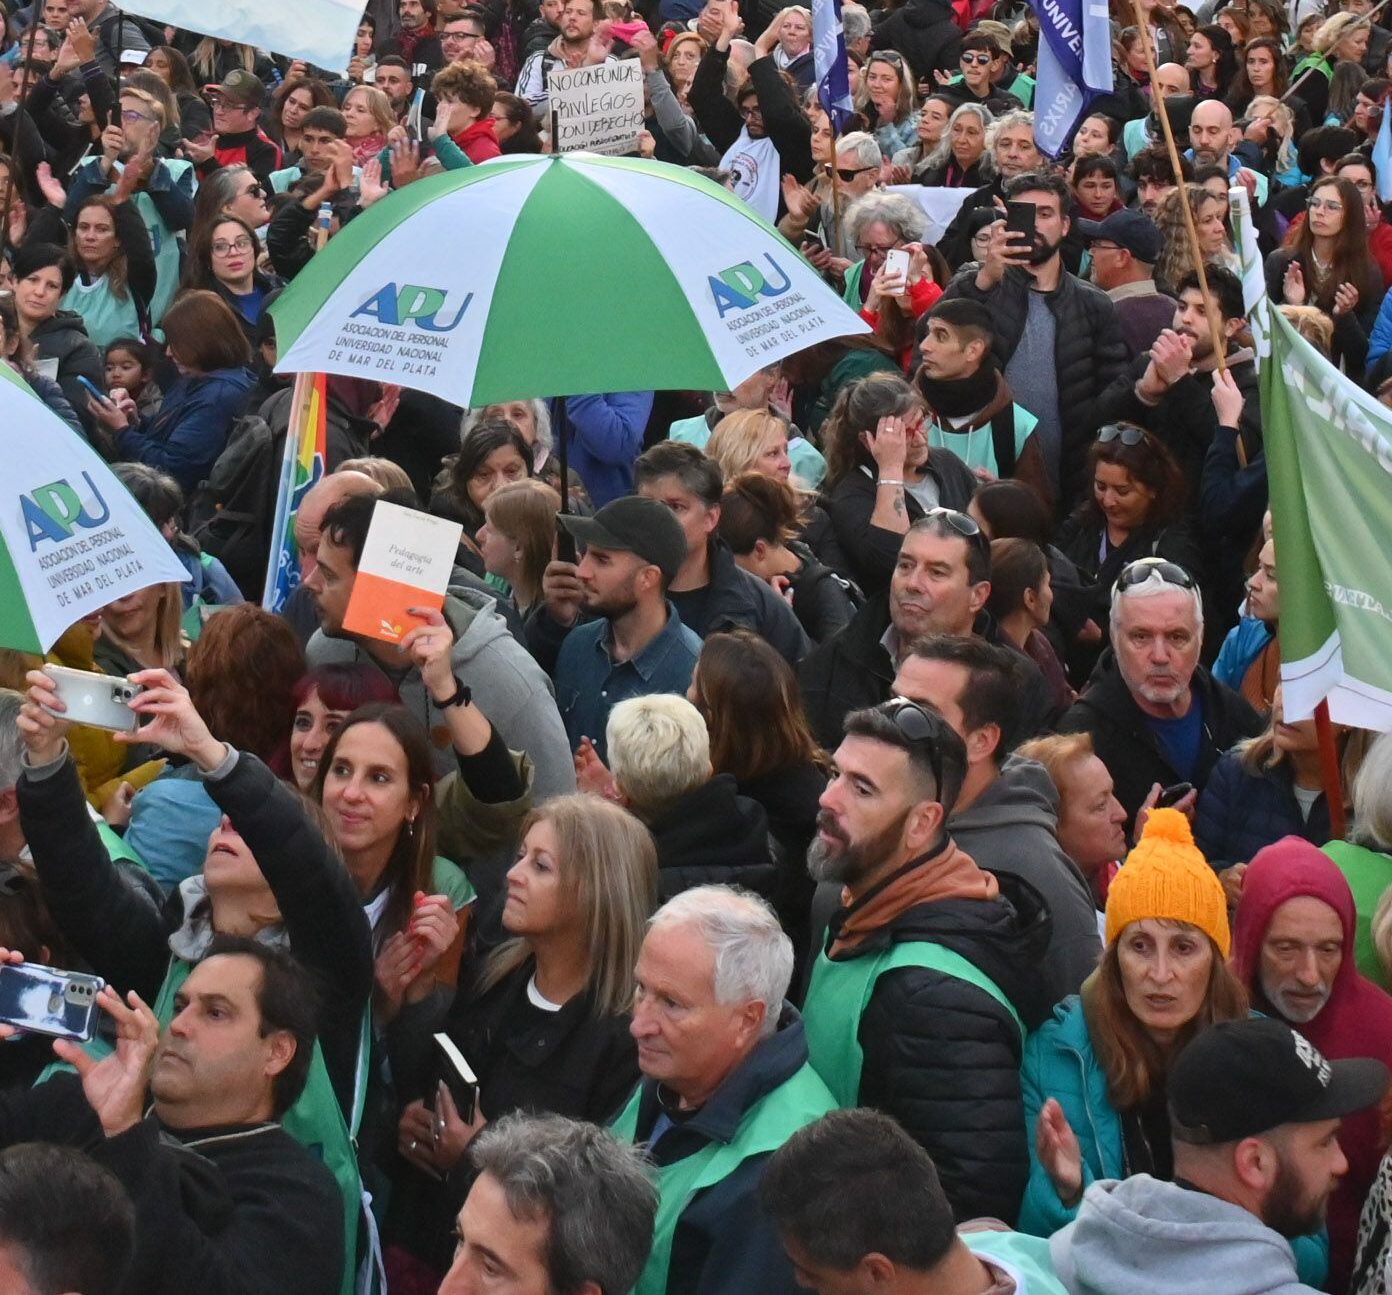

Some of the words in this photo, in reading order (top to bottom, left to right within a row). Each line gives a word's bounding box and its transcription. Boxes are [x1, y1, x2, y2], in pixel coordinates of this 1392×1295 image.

[549, 74, 572, 92] NO
[551, 92, 636, 118] PRIVILEGIOS
[558, 123, 585, 140] CON
[588, 110, 645, 136] DERECHOS
[708, 252, 791, 319] APU
[349, 282, 474, 332] APU
[726, 310, 765, 332] ASOCIACION
[761, 305, 776, 317] DEL
[736, 320, 780, 345] UNIVERSIDAD
[781, 304, 816, 325] NACIONAL
[335, 336, 392, 354] UNIVERSIDAD
[397, 346, 442, 362] NACIONAL
[342, 322, 391, 339] ASOCIACION
[390, 331, 405, 342] DEL
[408, 332, 449, 348] PERSONAL
[745, 346, 759, 358] DE
[760, 336, 780, 352] MAR
[780, 330, 798, 342] DEL
[799, 316, 826, 334] PLATA
[328, 350, 342, 362] DE
[348, 354, 371, 365] MAR
[376, 358, 394, 370] DEL
[402, 362, 436, 376] PLATA
[19, 470, 110, 553] APU
[38, 542, 79, 571] ASOCIACION
[76, 540, 92, 554] DEL
[88, 527, 125, 549] PERSONAL
[47, 559, 96, 589] UNIVERSIDAD
[97, 543, 135, 566] NACIONAL
[57, 591, 72, 607] DE
[72, 582, 94, 600] MAR
[96, 574, 115, 590] DEL
[115, 559, 144, 581] PLATA
